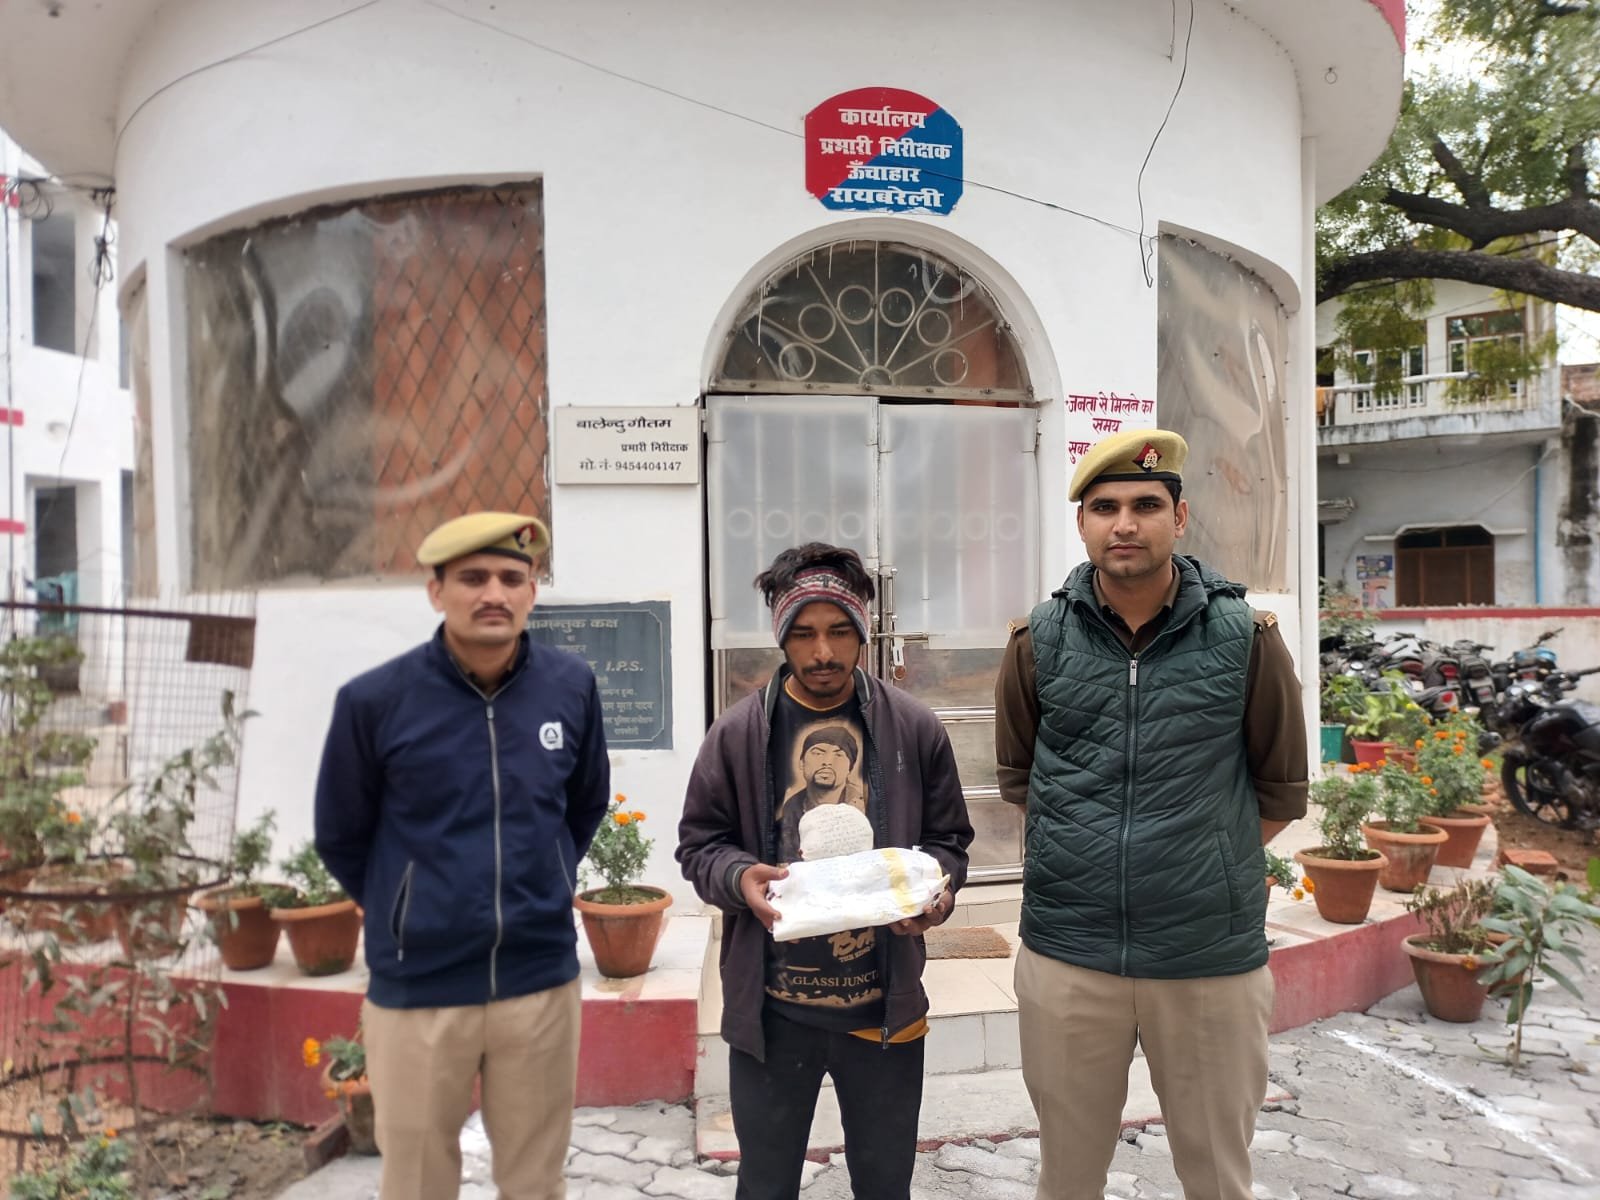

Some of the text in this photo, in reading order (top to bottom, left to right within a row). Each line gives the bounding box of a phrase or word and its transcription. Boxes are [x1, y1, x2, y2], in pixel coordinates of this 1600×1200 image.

[838, 106, 927, 128] कार्यालय
[819, 135, 952, 160] प्रभारी निरीक्षक
[828, 186, 944, 207] रायबरेली
[1066, 391, 1154, 416] जनता से मिलने का
[1092, 418, 1122, 434] समय
[621, 441, 647, 452] प्रभारी
[615, 461, 682, 471] 9454404147
[606, 660, 644, 671] I.P.S.
[842, 969, 878, 987] JUNCT
